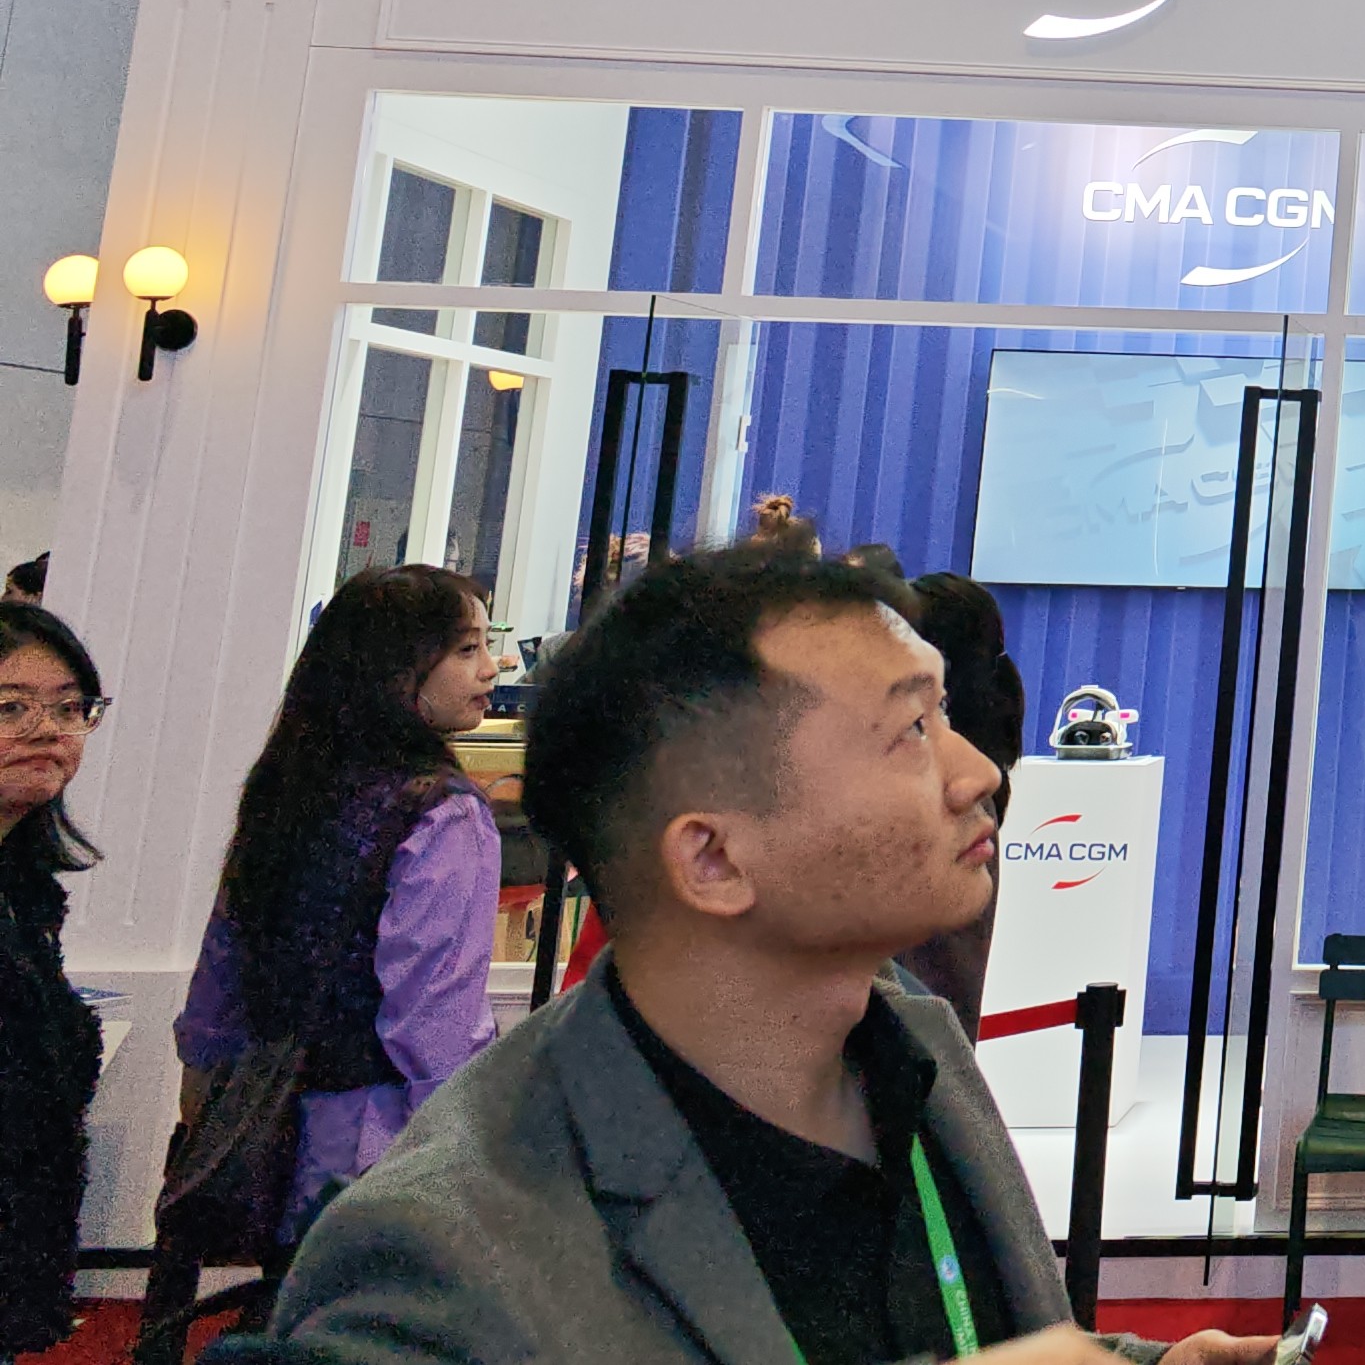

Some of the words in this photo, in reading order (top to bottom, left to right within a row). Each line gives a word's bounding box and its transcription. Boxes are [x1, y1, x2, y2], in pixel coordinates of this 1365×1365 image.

[1081, 180, 1214, 225] CMA
[1005, 842, 1063, 861] CMA
[1069, 842, 1128, 861] CGM
